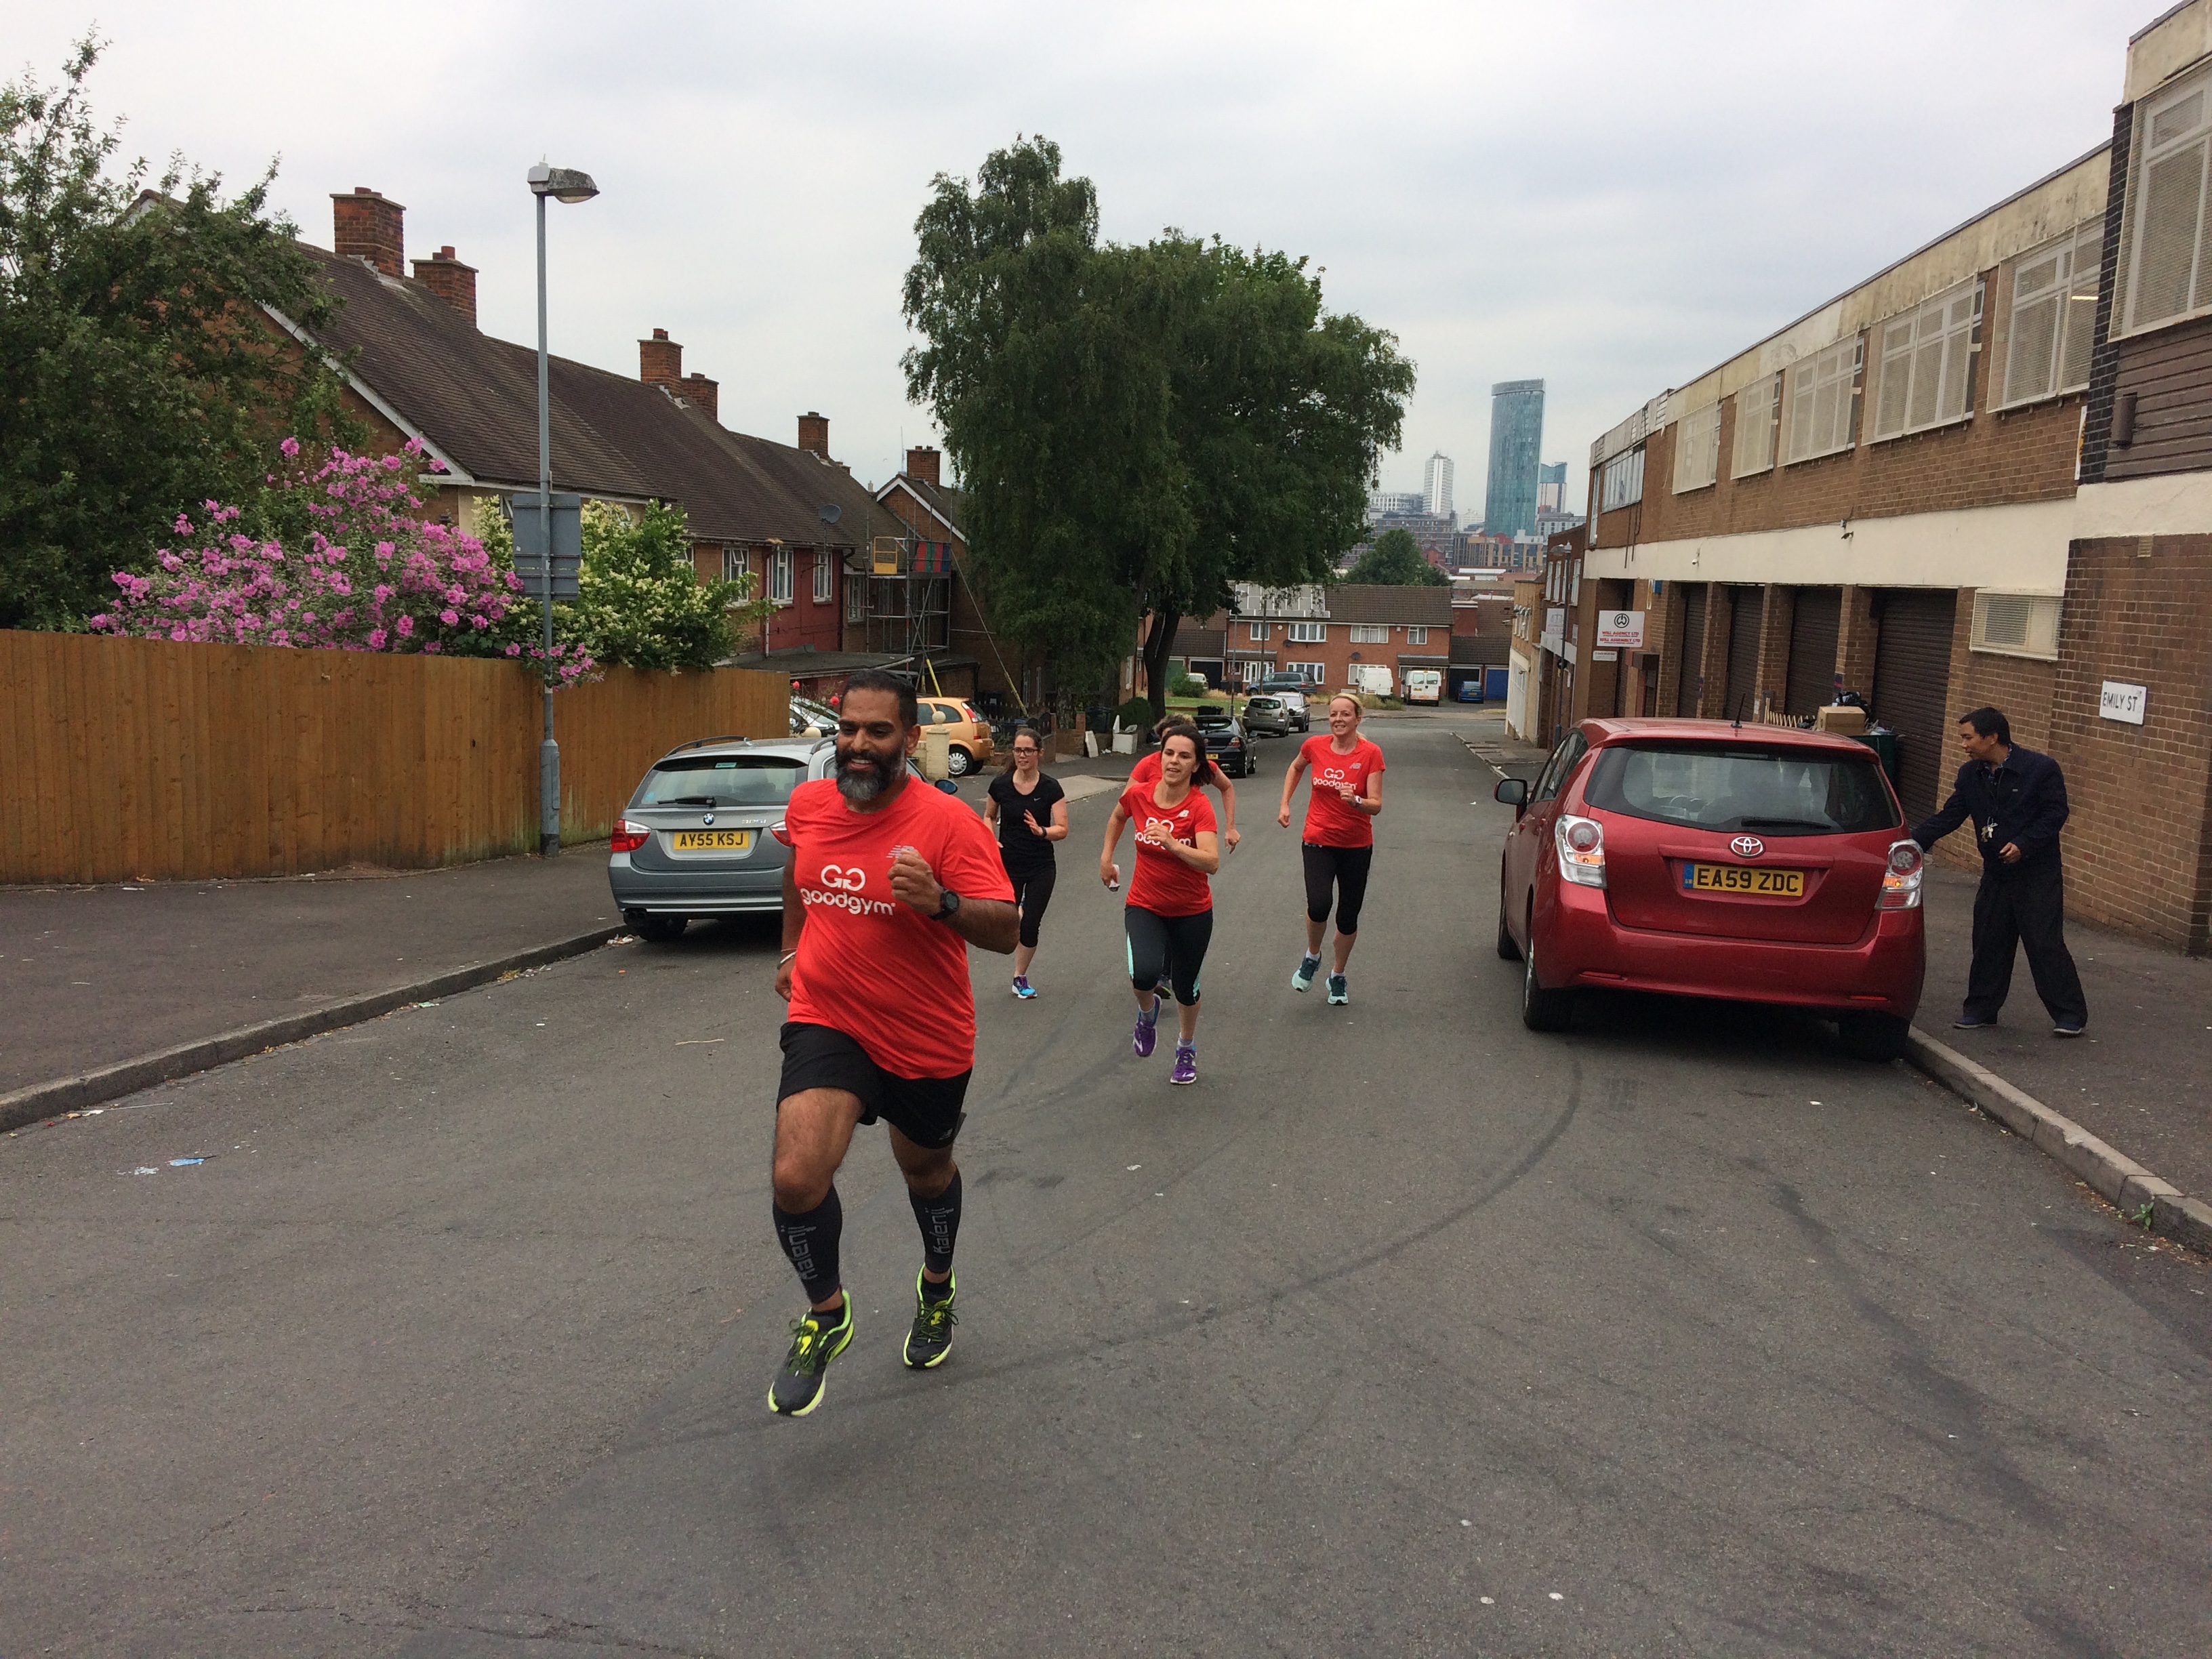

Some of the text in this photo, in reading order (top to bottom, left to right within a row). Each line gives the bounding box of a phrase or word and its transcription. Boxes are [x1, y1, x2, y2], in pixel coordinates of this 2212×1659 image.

[2102, 691, 2137, 712] EMILY ST
[679, 832, 744, 847] AY55 KSJ
[1697, 867, 1799, 893] EA59 ZDC
[800, 888, 894, 916] goodgym
